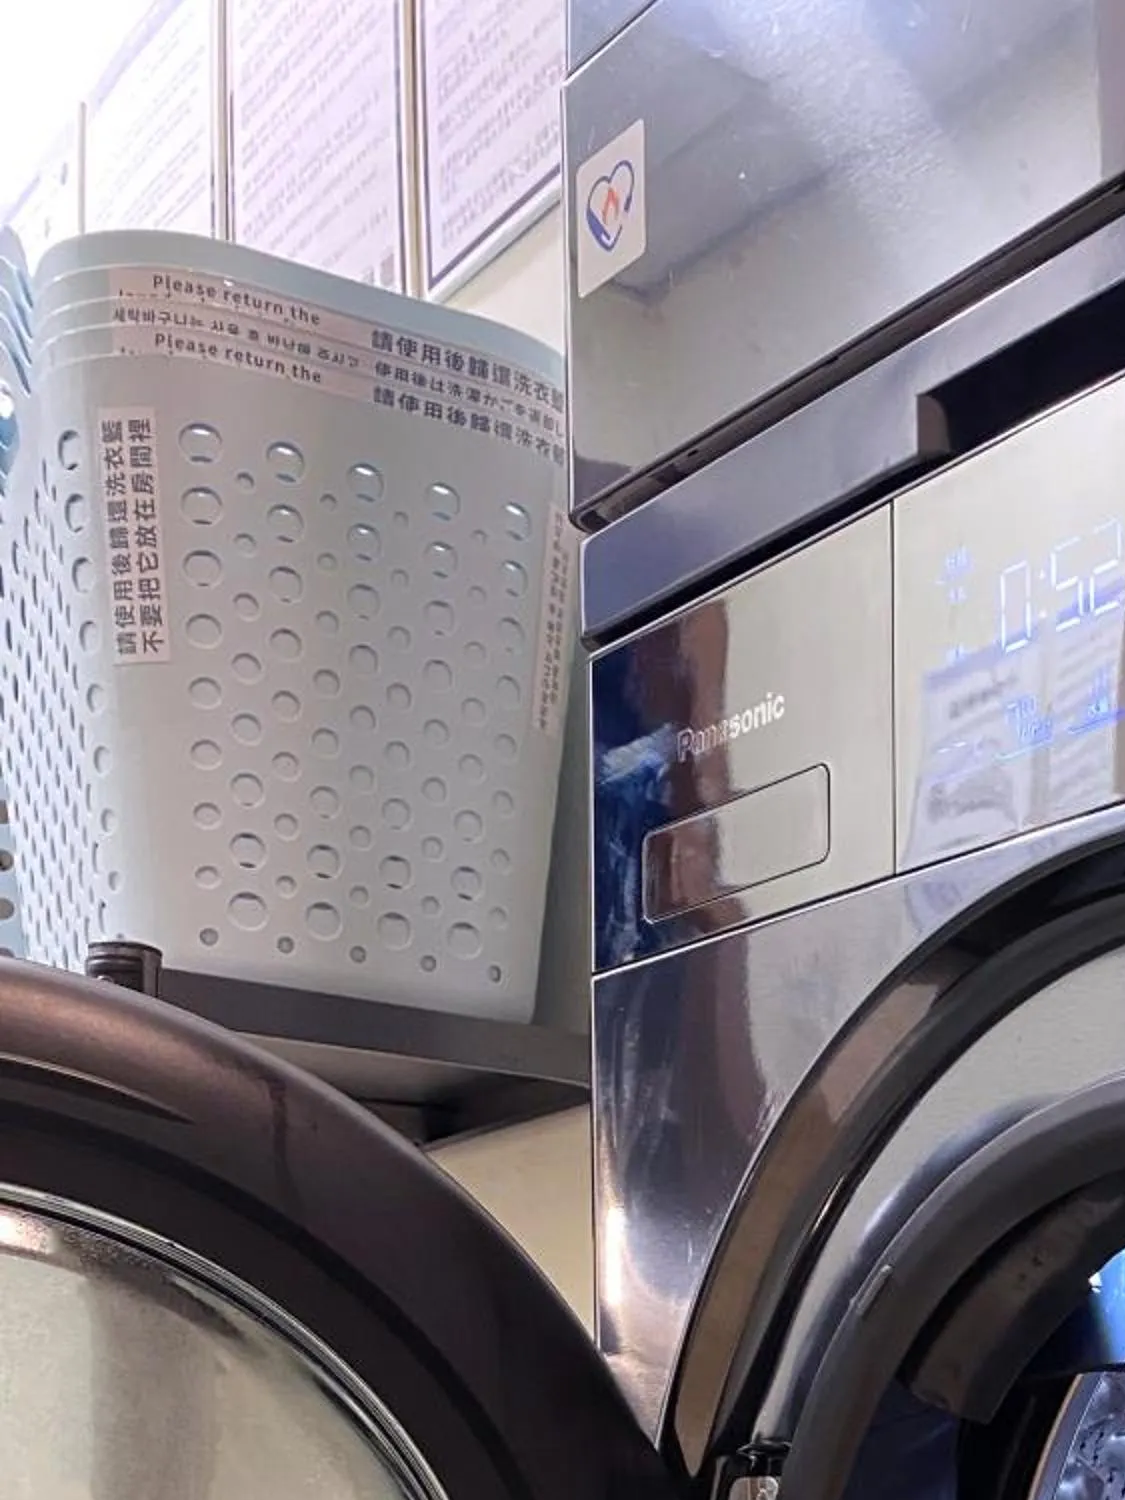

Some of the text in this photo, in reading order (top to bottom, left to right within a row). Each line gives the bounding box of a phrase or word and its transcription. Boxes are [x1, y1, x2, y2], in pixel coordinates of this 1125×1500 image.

[153, 274, 217, 300] Please
[224, 290, 283, 317] return
[291, 303, 321, 327] the
[154, 331, 322, 384] Please return the
[678, 691, 785, 763] Panasonic
